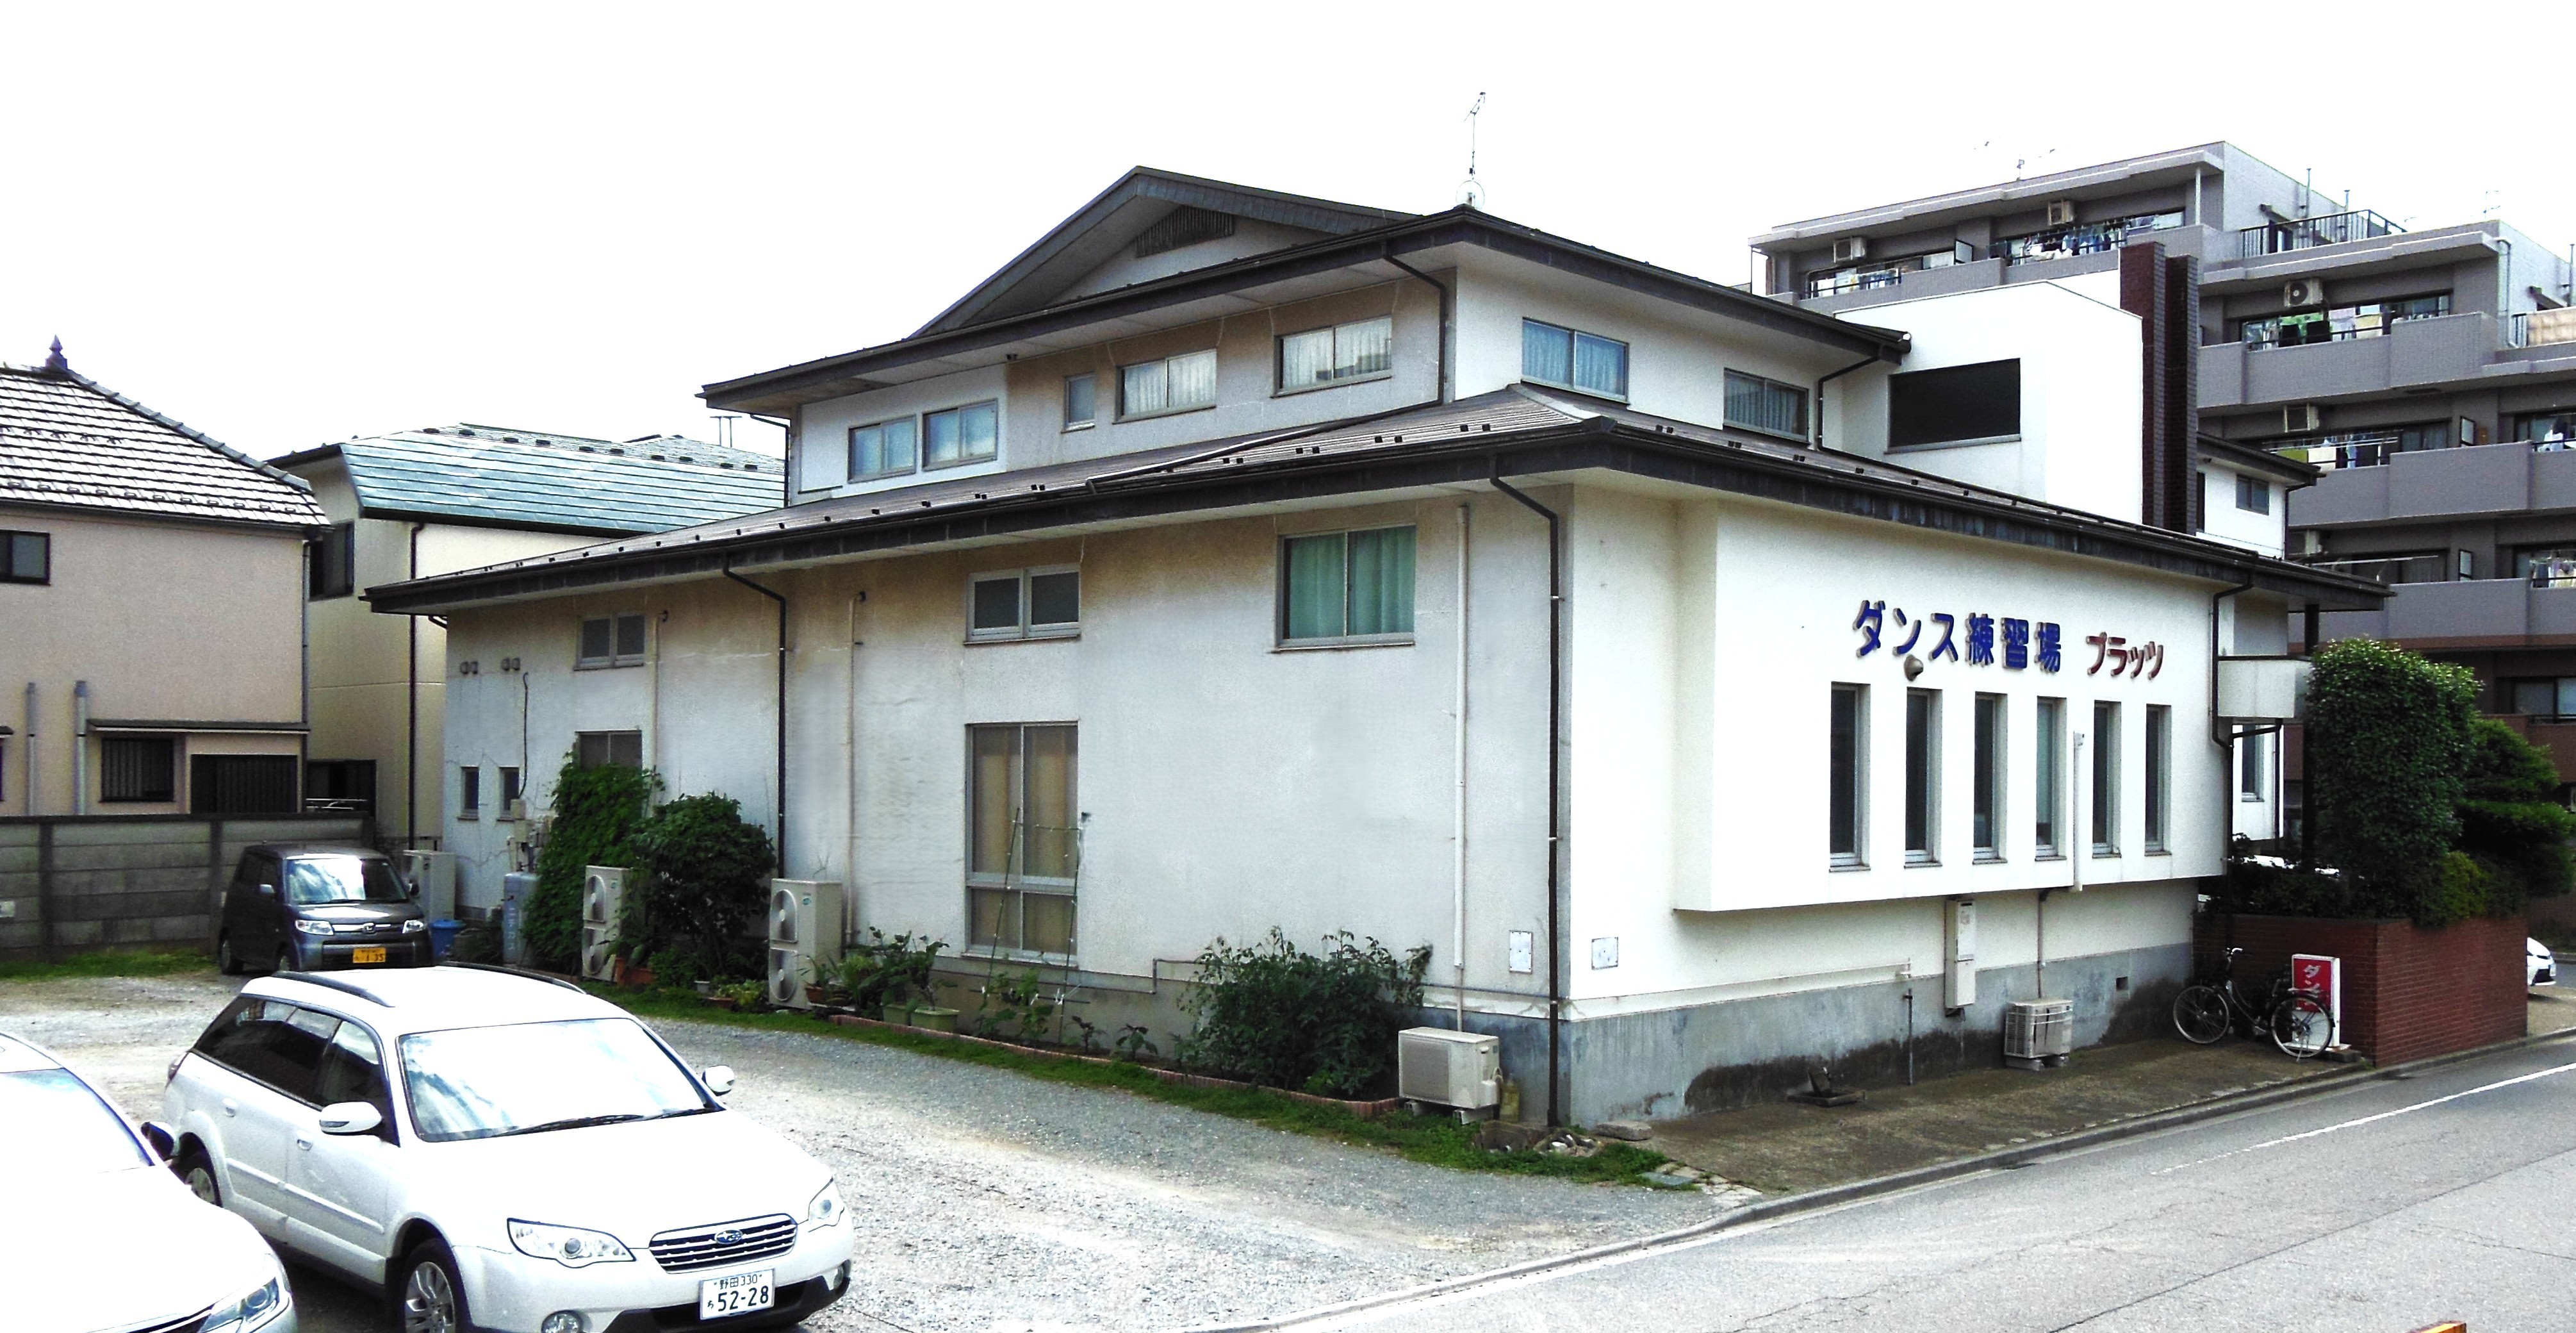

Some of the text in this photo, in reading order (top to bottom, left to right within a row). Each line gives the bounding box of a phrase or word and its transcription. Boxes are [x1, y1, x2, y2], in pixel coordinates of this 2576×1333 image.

[1852, 600, 2062, 673] ダンス練習場
[718, 1285, 769, 1312] 52-28
